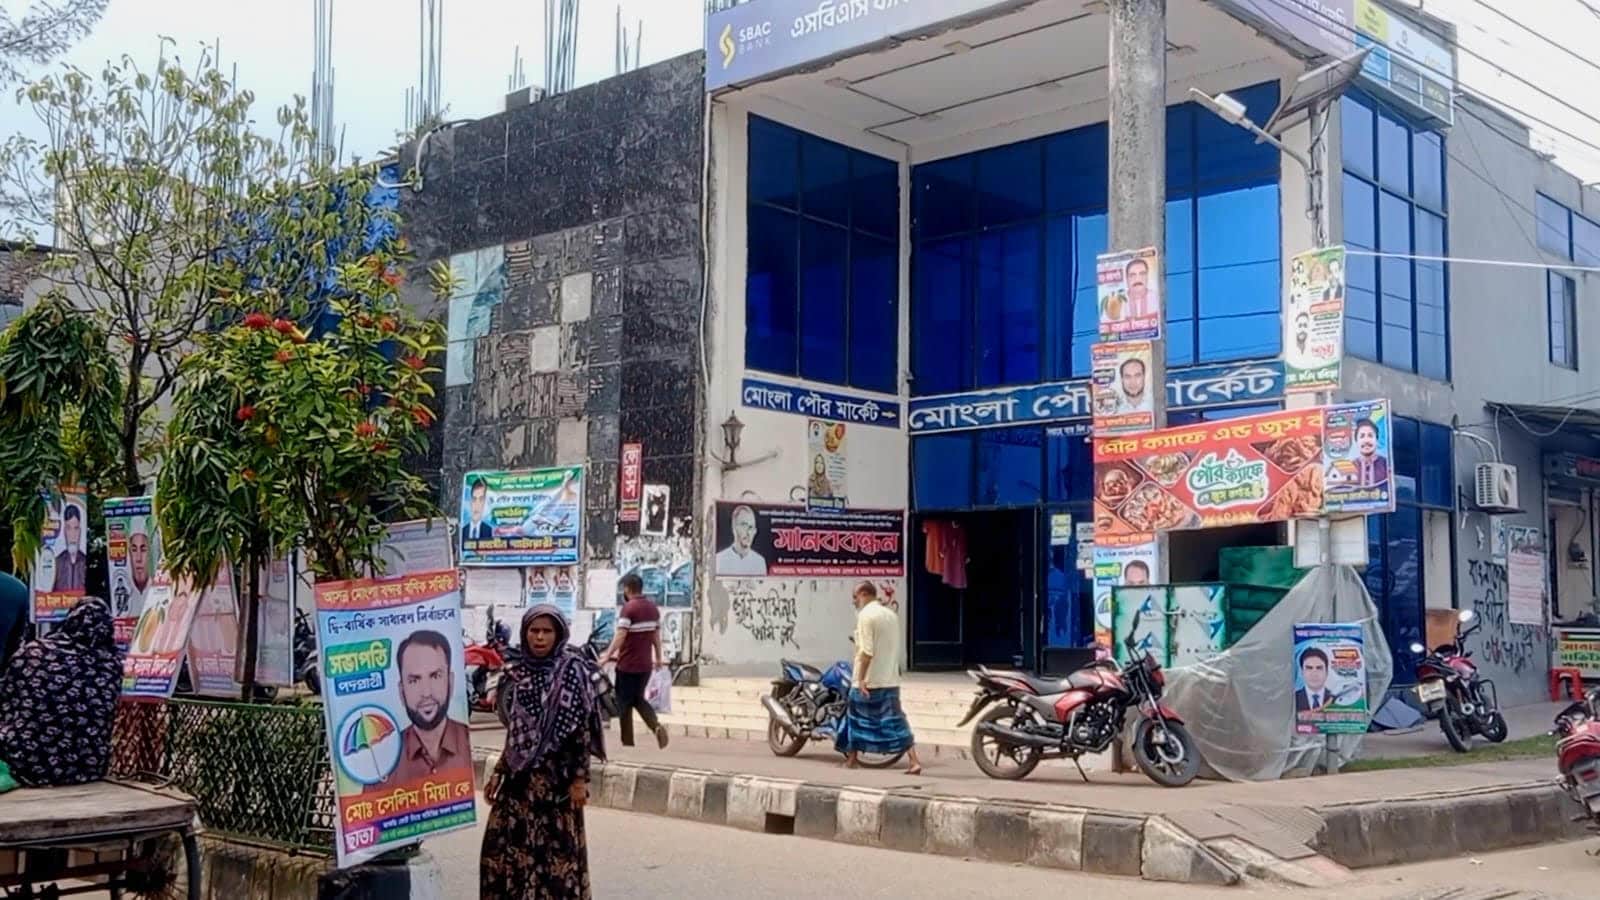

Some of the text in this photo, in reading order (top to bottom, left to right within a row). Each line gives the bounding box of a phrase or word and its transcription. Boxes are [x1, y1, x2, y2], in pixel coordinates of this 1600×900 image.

[739, 22, 771, 42] SBAC
[743, 386, 880, 421] মোংলা পৌর মার্কেট
[908, 397, 1020, 429] মোংলা
[1032, 384, 1091, 417] পৌ
[771, 526, 900, 556] মানববন্ধন
[378, 613, 415, 627] সাধারণ
[416, 605, 455, 623] নির্বাচনে
[328, 641, 388, 675] সভাপতি
[345, 800, 373, 822] মোঃ
[377, 788, 419, 816] সেলিম
[424, 781, 451, 804] মিয়া
[454, 782, 471, 797] কে
[344, 826, 375, 850] ছাতা
